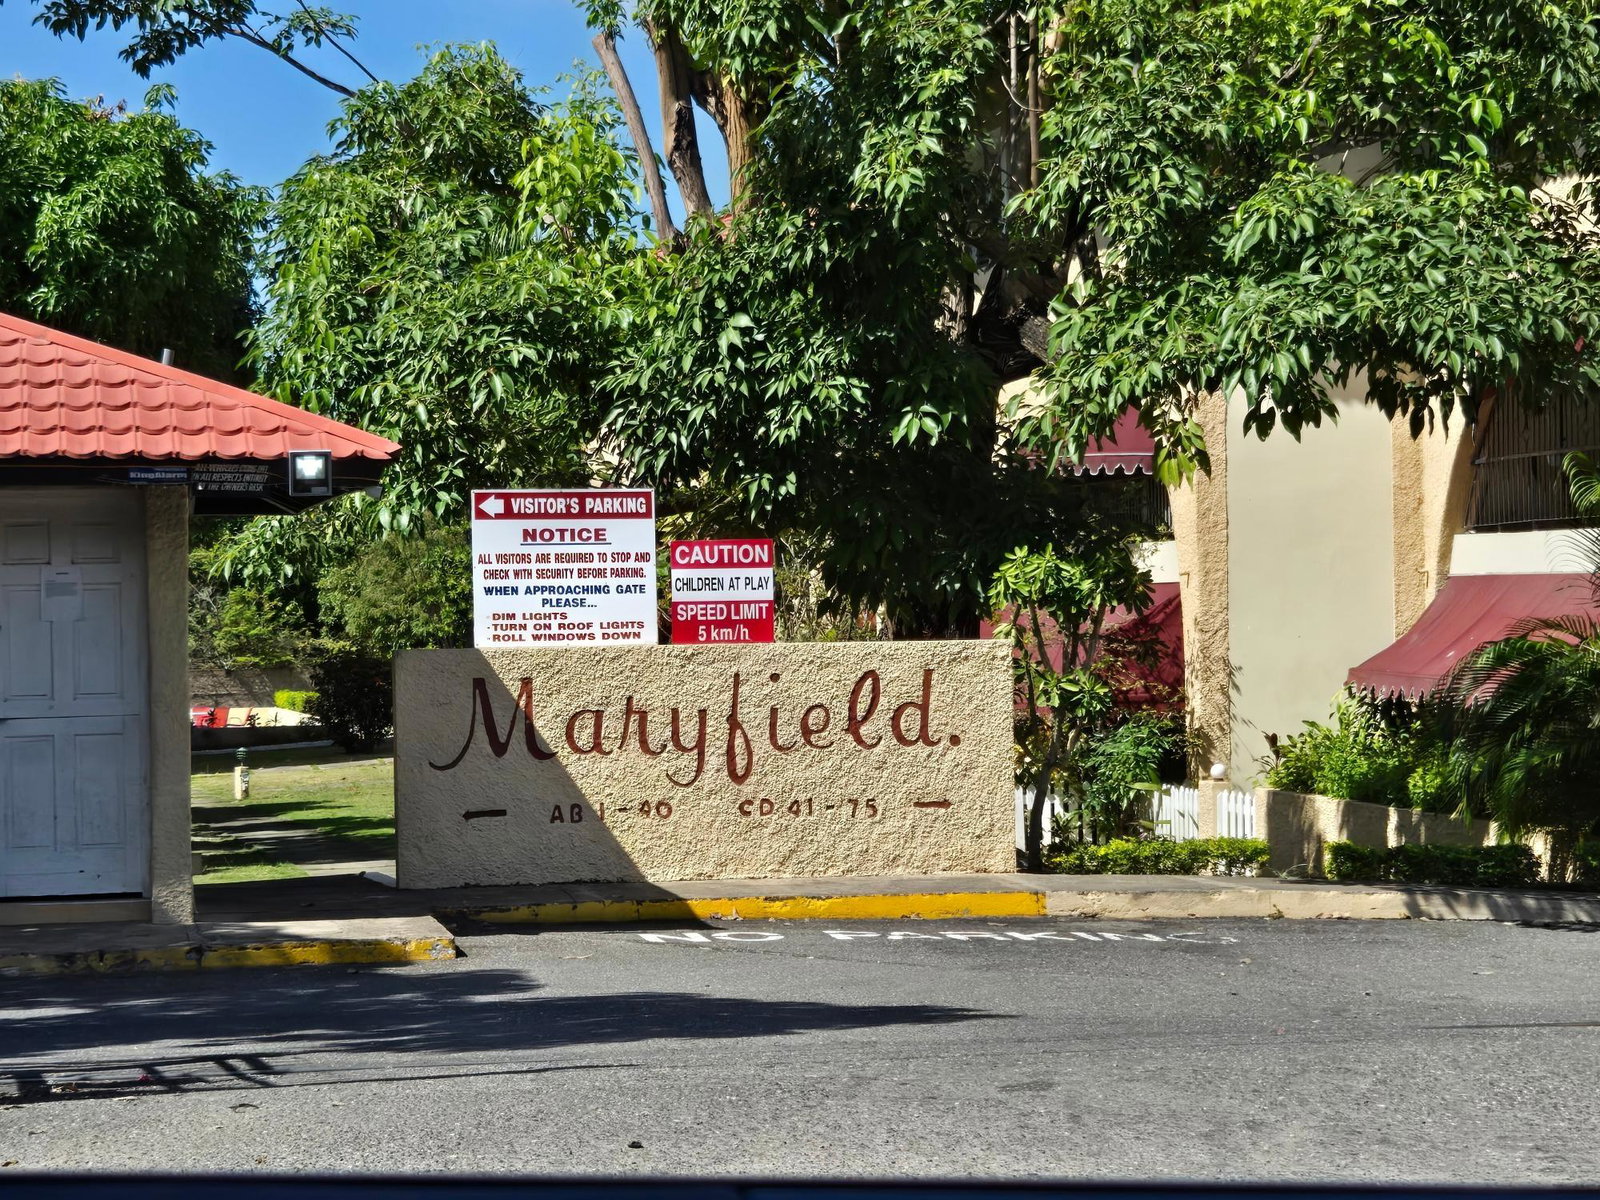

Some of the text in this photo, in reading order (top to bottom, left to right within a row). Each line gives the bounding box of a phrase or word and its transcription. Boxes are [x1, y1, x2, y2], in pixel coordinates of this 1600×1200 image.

[212, 472, 242, 481] RESPECTS
[511, 497, 647, 514] VISITOR'S PARKING
[522, 528, 607, 543] NOTICE
[478, 552, 651, 565] ALL VISITORS ARE REQUIRED TO STOP AND
[675, 544, 769, 564] CAUTION
[484, 567, 646, 580] CHECK WITH SECURITY BEFORE PARKING.
[484, 584, 646, 596] WHEN APPROACHING GATE
[675, 576, 770, 592] CHILDREN AT PLAY
[541, 598, 597, 608] PLEASE...
[522, 612, 568, 620] LIGHTS
[677, 603, 769, 621] SPEED LIMIT
[533, 623, 552, 631] ON
[558, 622, 594, 630] ROOF
[600, 621, 645, 629] LIGHTS
[698, 624, 749, 641] 5 km/h
[532, 633, 596, 641] WINDOWS
[602, 632, 641, 640] DOWN
[550, 804, 584, 824] AB
[738, 798, 773, 817] CD
[636, 929, 1239, 945] NO PARKING
